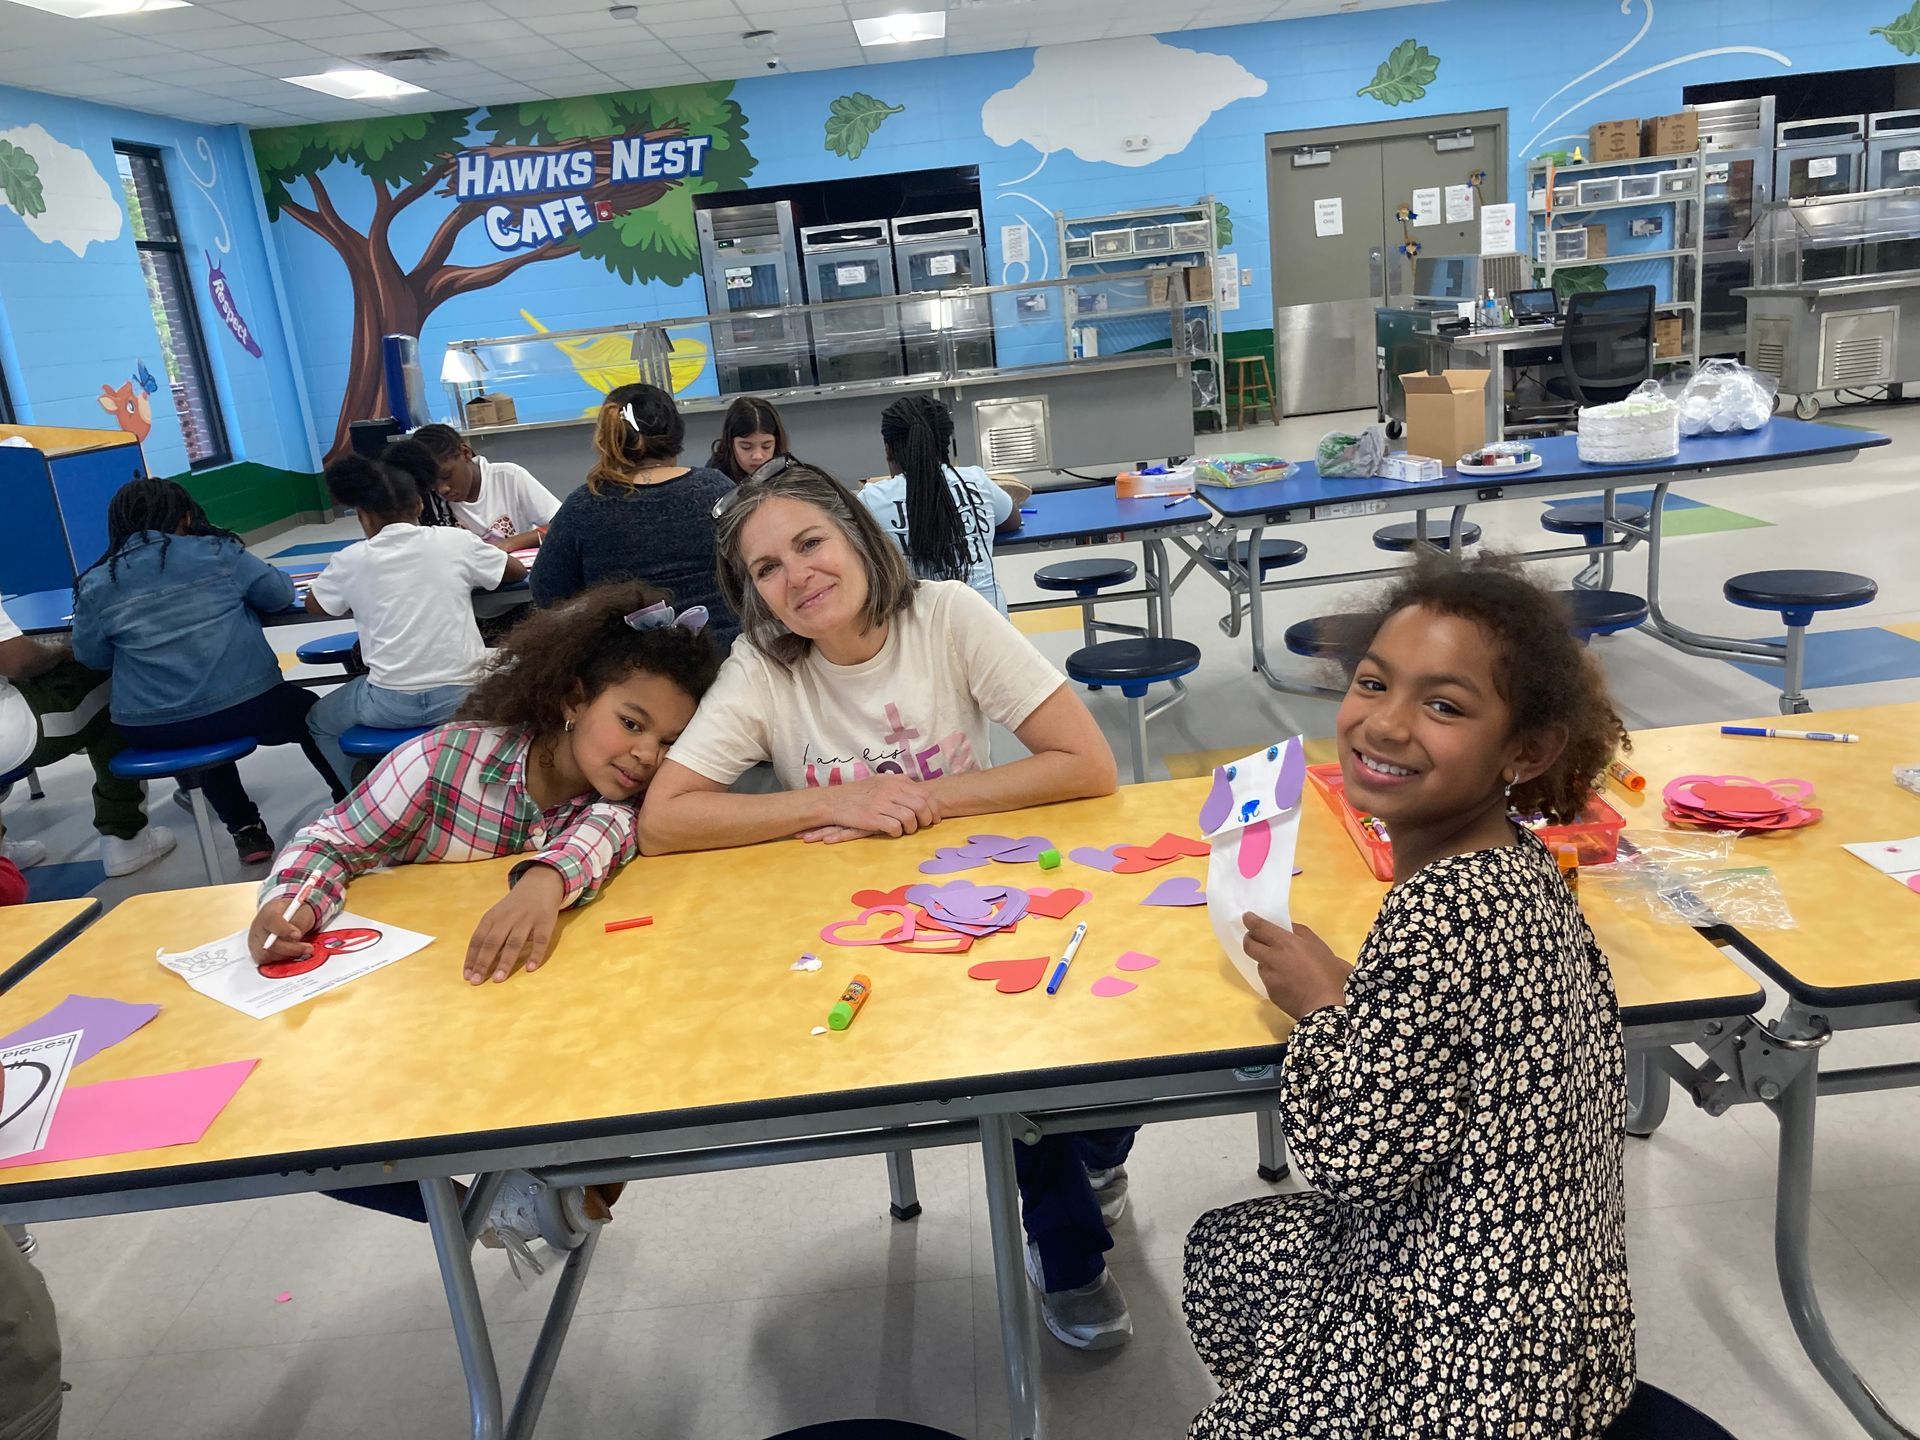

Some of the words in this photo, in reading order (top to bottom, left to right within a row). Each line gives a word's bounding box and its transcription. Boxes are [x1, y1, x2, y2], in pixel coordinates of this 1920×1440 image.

[457, 151, 594, 198] HAWKS
[611, 137, 709, 181] NEST
[485, 195, 594, 248] CAFE
[212, 278, 248, 345] Respect
[816, 756, 855, 765] am
[862, 747, 907, 762] his
